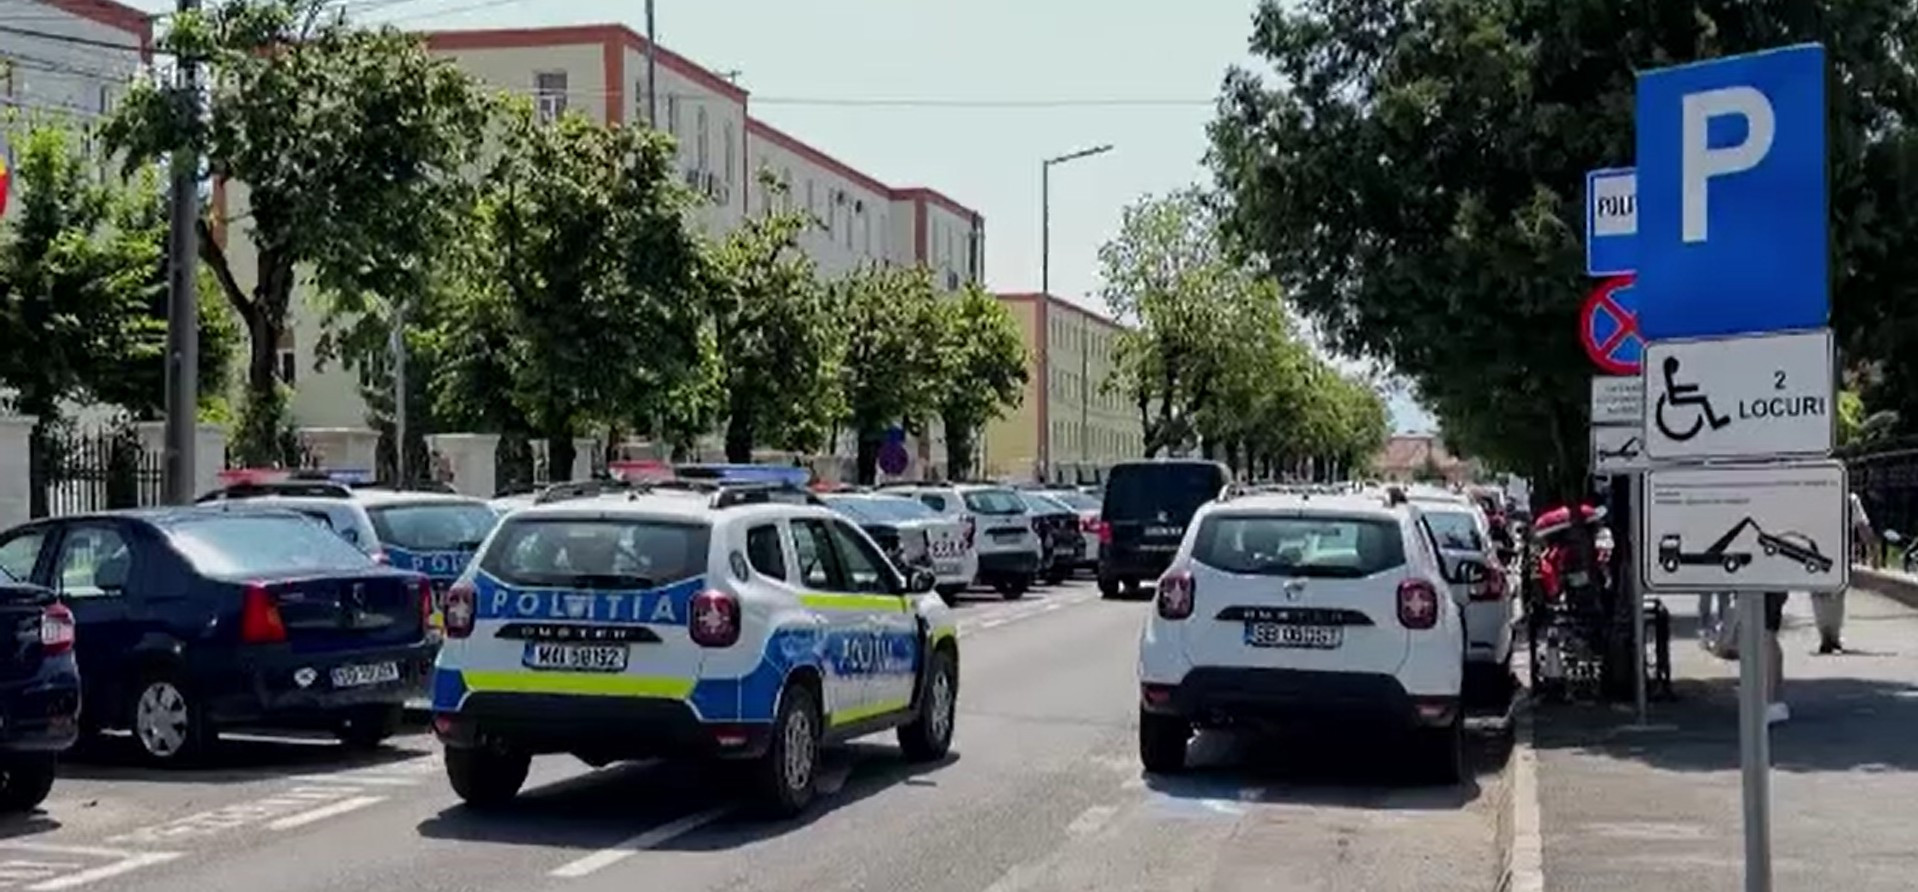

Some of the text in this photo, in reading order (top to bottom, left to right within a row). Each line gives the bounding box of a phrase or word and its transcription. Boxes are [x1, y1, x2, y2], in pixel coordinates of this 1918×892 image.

[1682, 85, 1776, 242] P
[1598, 196, 1637, 217] POLI
[1773, 370, 1787, 390] 2
[1738, 397, 1827, 419] LOCURI
